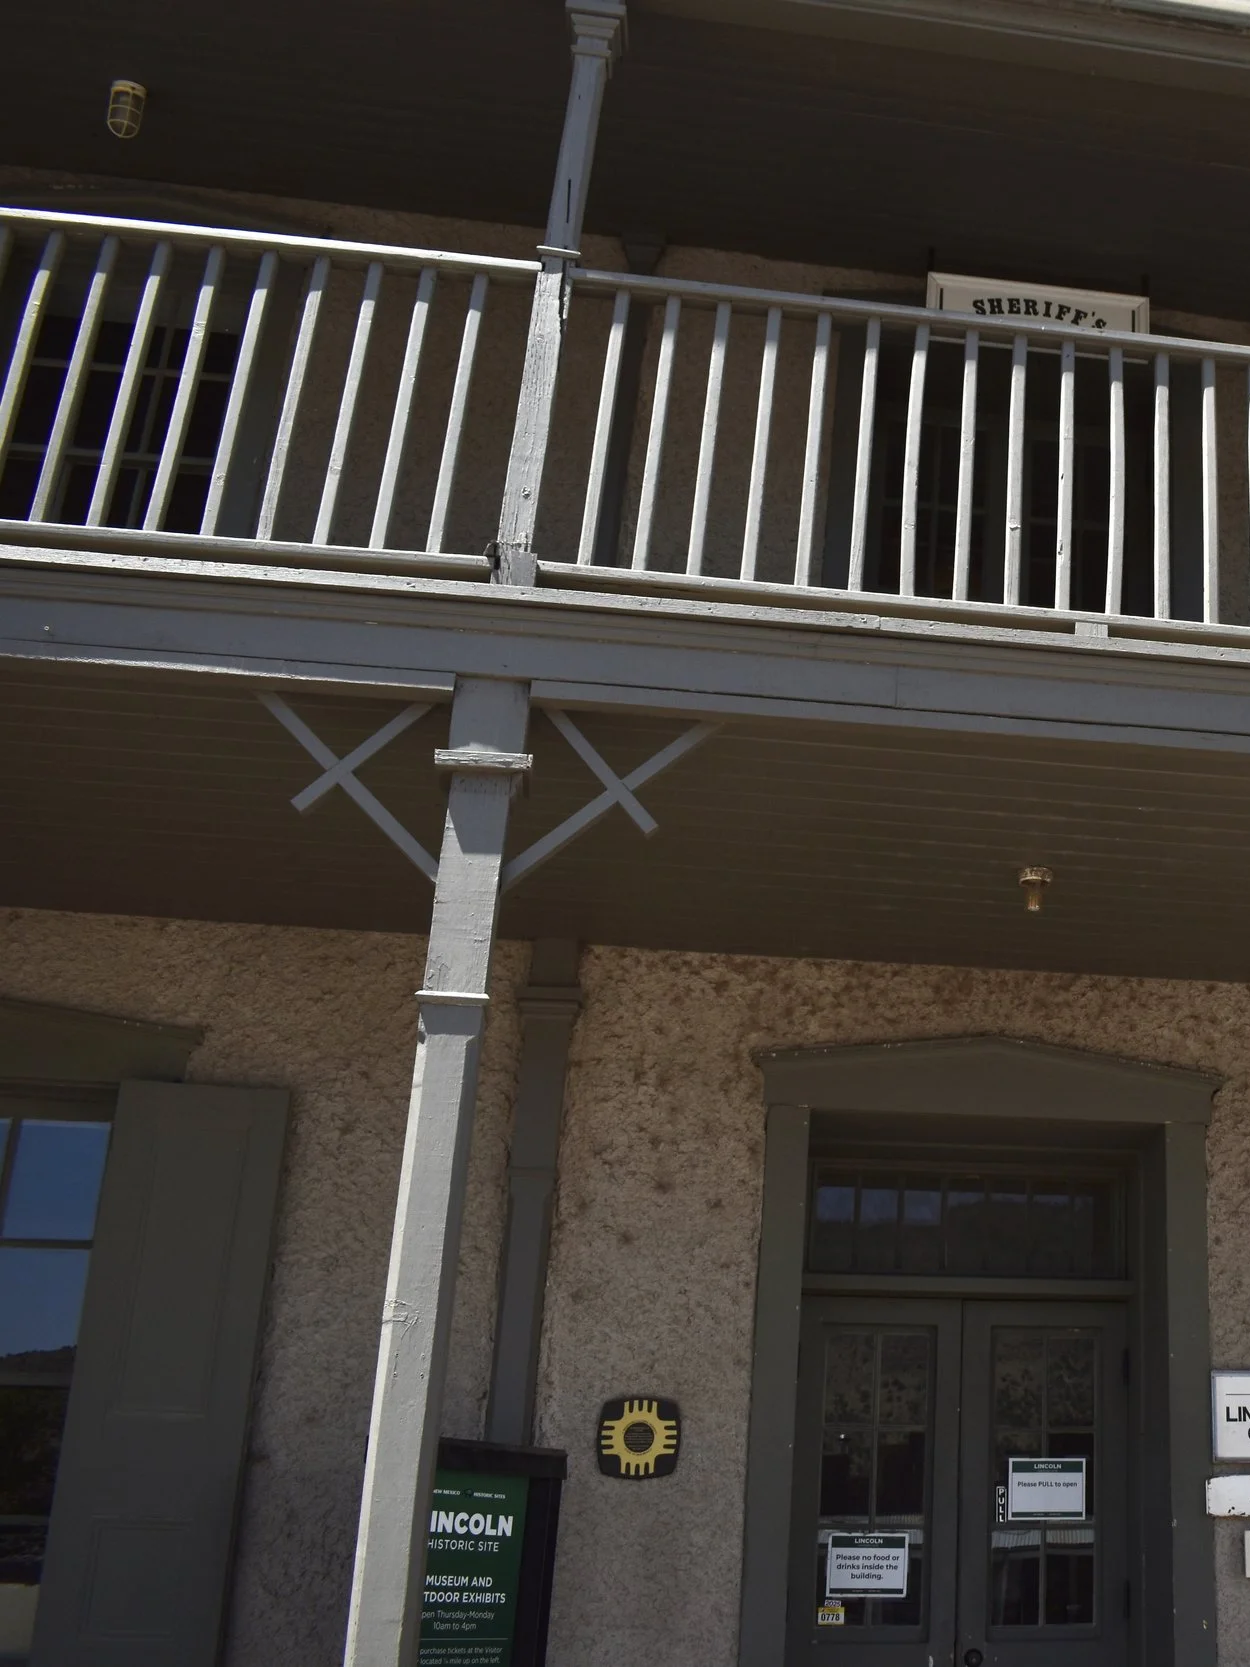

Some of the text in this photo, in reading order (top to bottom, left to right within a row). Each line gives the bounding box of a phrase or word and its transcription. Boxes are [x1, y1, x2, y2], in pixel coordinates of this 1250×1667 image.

[972, 298, 1107, 328] SHERIFF'S
[430, 1510, 514, 1537] INCOLN
[477, 1541, 499, 1552] SITE
[425, 1575, 493, 1587] MUSEUM AND
[851, 1573, 883, 1581] building.
[423, 1591, 506, 1604] TDOOR EXHIBITS
[421, 1610, 495, 1620] pen Thursday-Monday
[821, 1613, 840, 1621] 0778
[433, 1621, 477, 1631] 10am to 4pm
